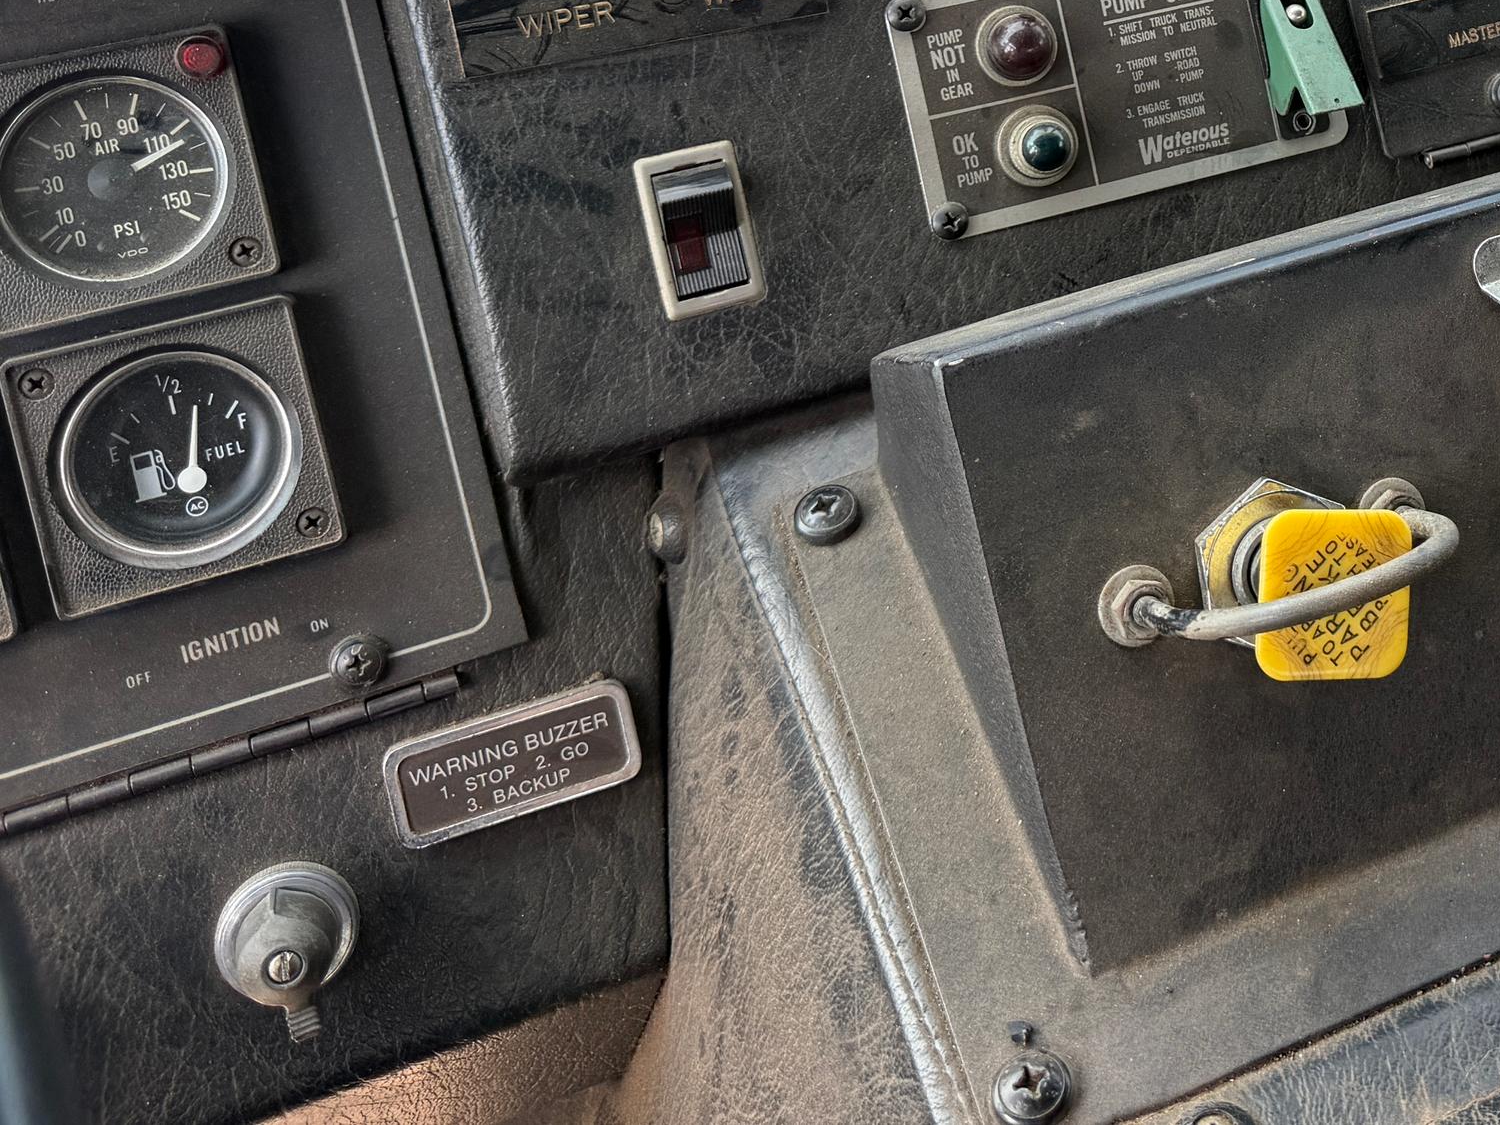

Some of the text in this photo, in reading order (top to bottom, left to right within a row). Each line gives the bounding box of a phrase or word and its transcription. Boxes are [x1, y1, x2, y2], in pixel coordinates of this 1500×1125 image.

[516, 1, 616, 38] WIPER
[1108, 5, 1214, 37] 1. SHIFT TRUCK TRANS-
[926, 28, 963, 49] PUMP
[1120, 16, 1218, 46] MISSION TO NEUTRAL
[929, 44, 966, 70] NOT
[1126, 55, 1158, 71] THROW
[1164, 46, 1197, 62] SWITCH
[946, 67, 960, 84] IN
[1131, 70, 1144, 81] UP
[940, 82, 974, 101] GEAR
[1134, 79, 1161, 94] DOWN
[1125, 91, 1205, 119] 3. ENGAGE TRUCK
[118, 117, 139, 136] 90
[1142, 105, 1206, 129] TRANSMISSION
[80, 120, 103, 140] 70
[53, 141, 76, 161] 50
[94, 138, 121, 156] AIR
[143, 134, 171, 154] 110
[952, 131, 979, 156] OK
[1138, 122, 1230, 166] Waterous
[1166, 137, 1231, 159] DEPENDABLE
[158, 160, 190, 179] 130
[962, 154, 980, 170] TO
[41, 175, 64, 195] 30
[957, 167, 993, 188] PUMP
[161, 189, 192, 211] 150
[55, 207, 75, 225] 10
[75, 230, 87, 247] 0
[113, 220, 141, 239] PSI
[117, 246, 149, 259] VDO
[237, 412, 247, 429] F
[108, 445, 121, 464] E
[205, 440, 246, 462] FUEL
[1324, 539, 1389, 612] PH TO
[1305, 549, 1380, 632] BKE
[1281, 563, 1370, 662] PARNG
[310, 618, 330, 633] ON
[180, 616, 281, 664] IGNITION
[1322, 639, 1344, 666] TO
[125, 670, 152, 689] OFF
[408, 711, 609, 787] WARNING BUZZER
[440, 742, 589, 800] 1. STOP 2. GO
[466, 767, 571, 813] 3. BACKUP
